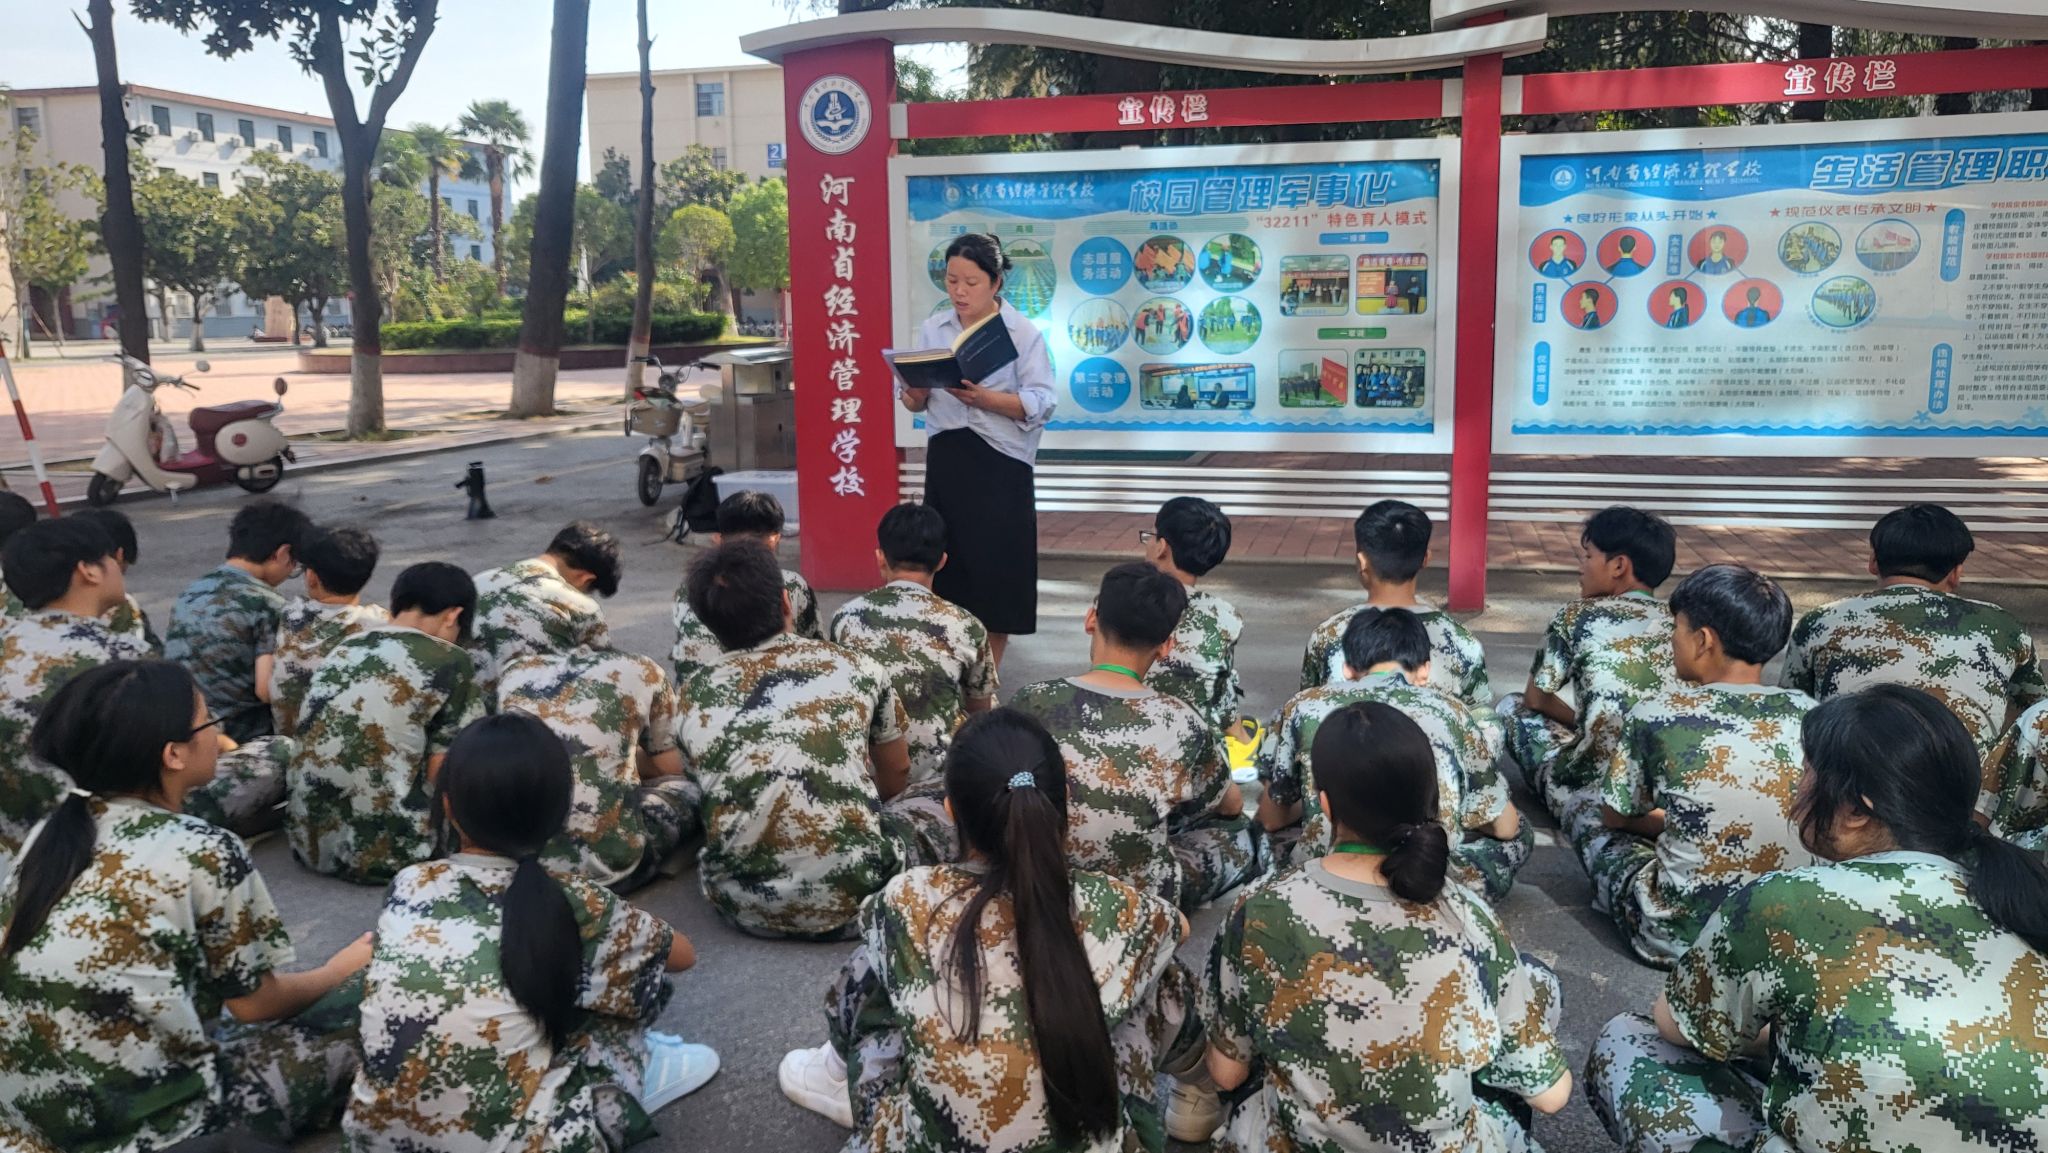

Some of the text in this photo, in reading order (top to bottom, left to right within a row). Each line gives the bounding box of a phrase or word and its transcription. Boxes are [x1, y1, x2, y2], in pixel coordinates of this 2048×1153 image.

[1783, 59, 1897, 96] 宣传栏
[1118, 93, 1209, 125] 宣传栏
[770, 145, 780, 159] 2
[1584, 160, 1763, 181] 河南省经济管理学校
[1127, 171, 1392, 215] 校园管理军事化
[1577, 209, 1703, 224] 良好形象从头开始
[1784, 202, 1921, 217] 规范仪表传承文明
[1082, 252, 1121, 265] 志愿服
[1082, 267, 1121, 281] 务活动
[819, 173, 865, 496] 河南省经济管理学校
[1074, 372, 1127, 384] 第二堂课
[1088, 386, 1114, 398] 活动
